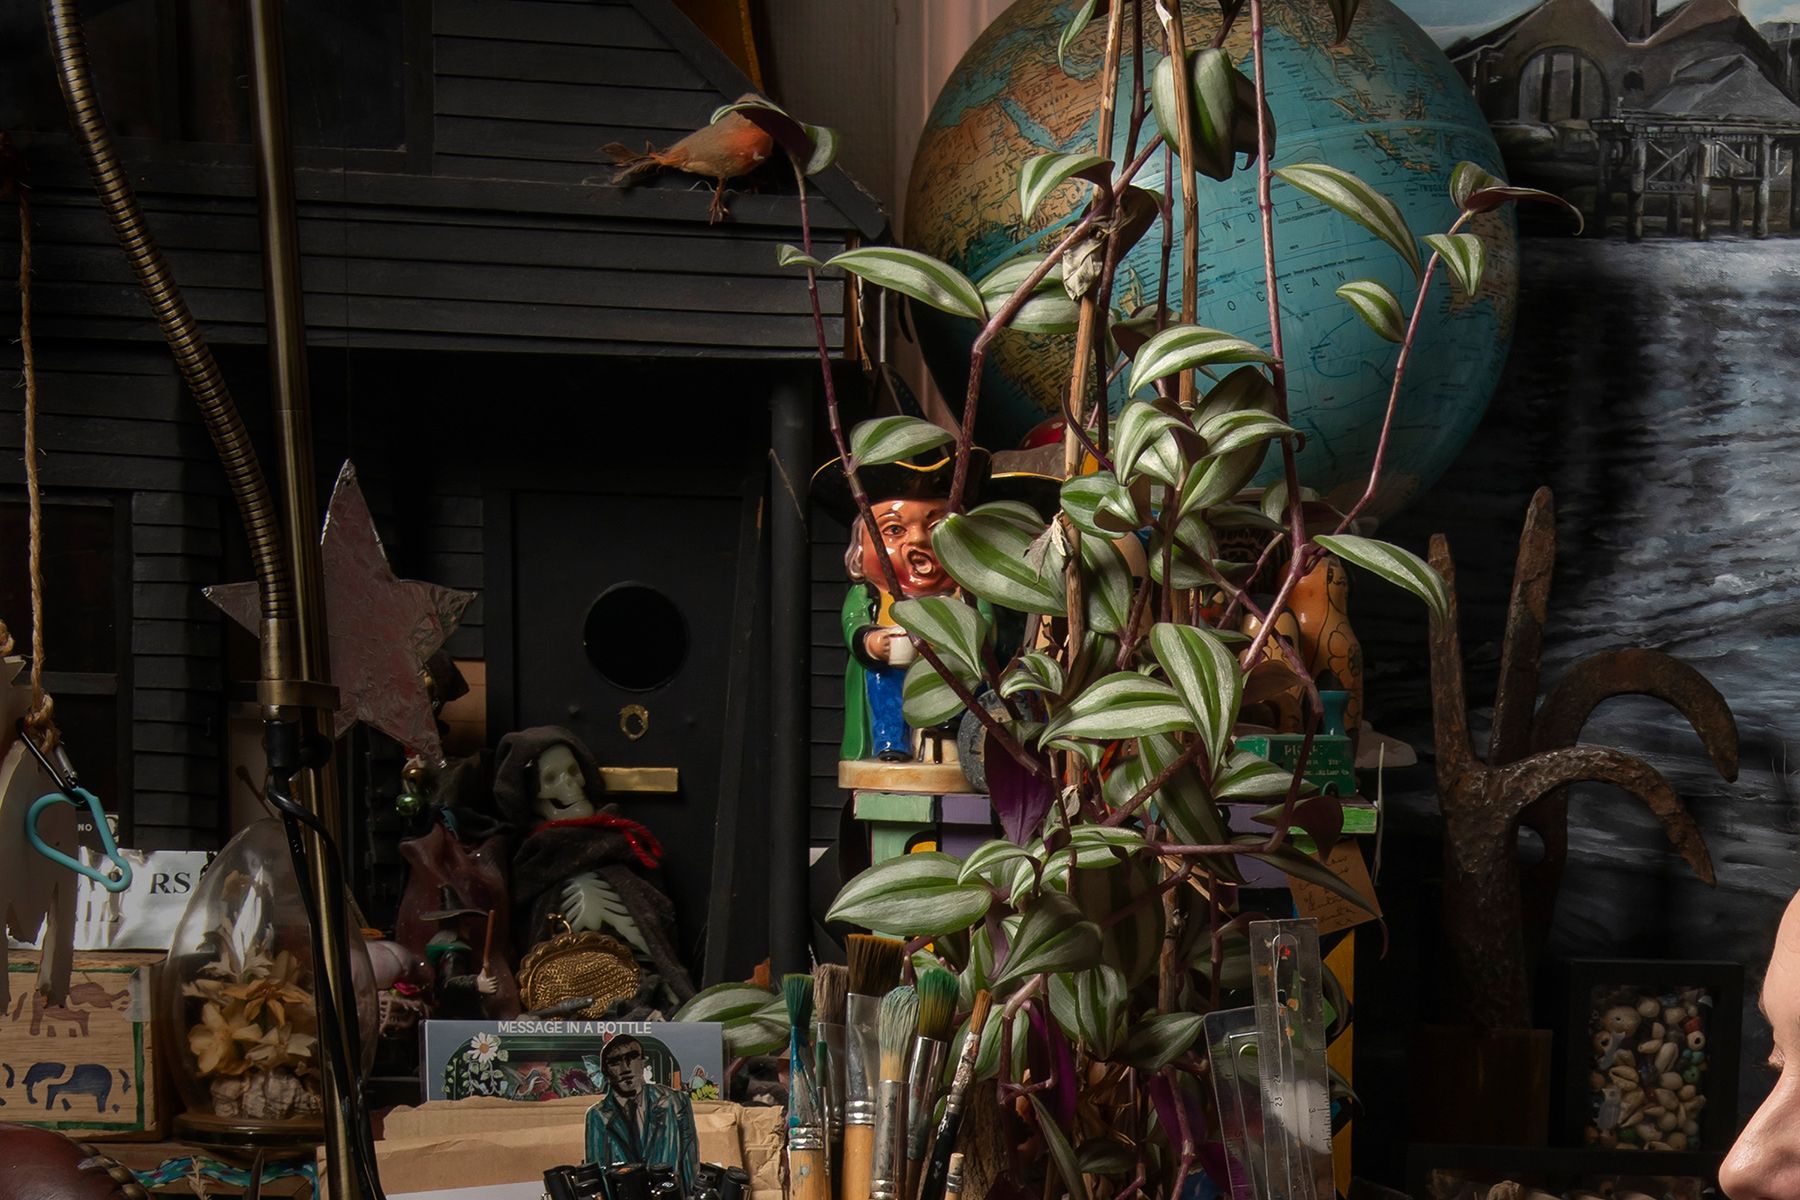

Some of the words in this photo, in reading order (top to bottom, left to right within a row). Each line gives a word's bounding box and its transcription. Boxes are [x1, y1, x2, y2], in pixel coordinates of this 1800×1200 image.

[1227, 270, 1347, 312] OCEAN
[149, 872, 193, 894] RS
[498, 1021, 563, 1034] MESSAGE
[567, 1021, 581, 1034] IN
[584, 1021, 594, 1034] A
[597, 1021, 652, 1034] BOTTLE
